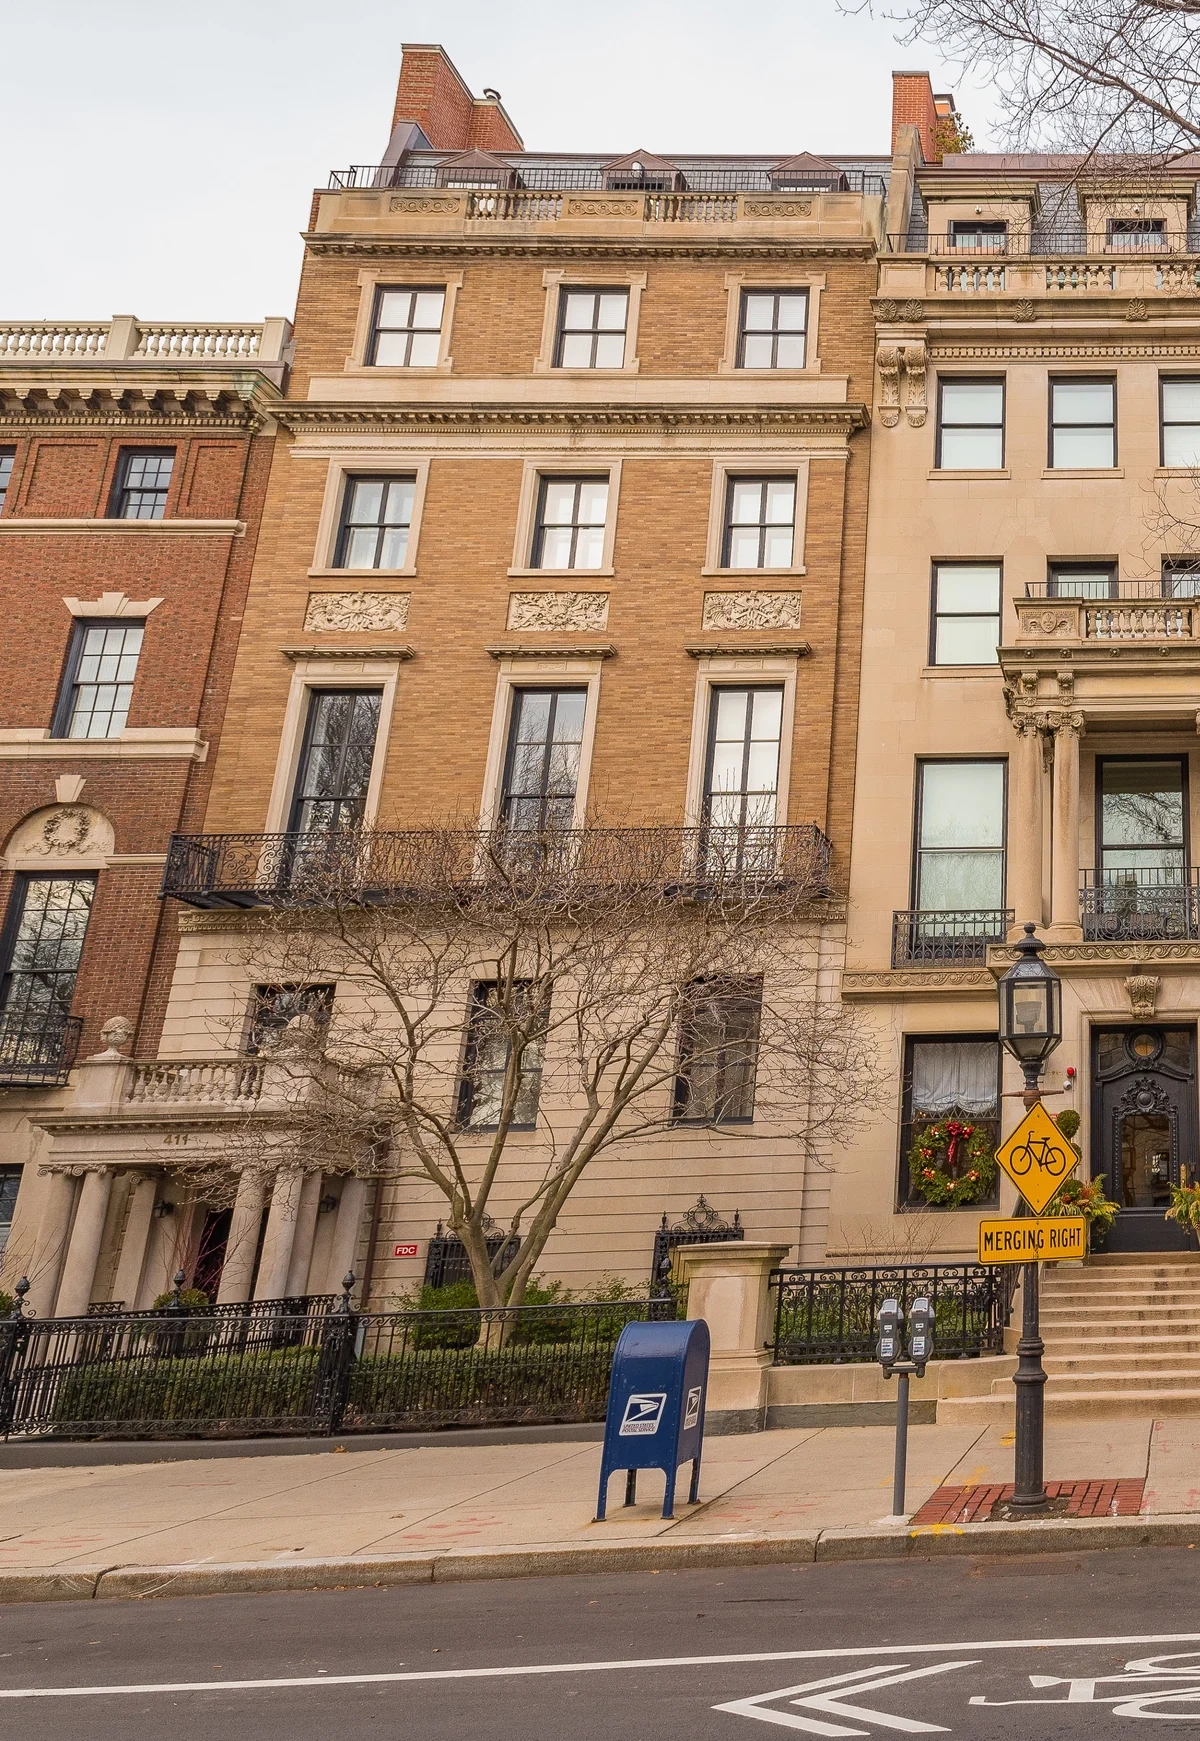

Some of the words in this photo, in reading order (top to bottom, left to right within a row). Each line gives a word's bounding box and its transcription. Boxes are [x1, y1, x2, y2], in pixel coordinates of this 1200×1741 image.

[163, 1134, 189, 1146] 411
[984, 1230, 1044, 1251] MERGING
[1050, 1228, 1081, 1248] RIGHT
[396, 1246, 415, 1255] FDC
